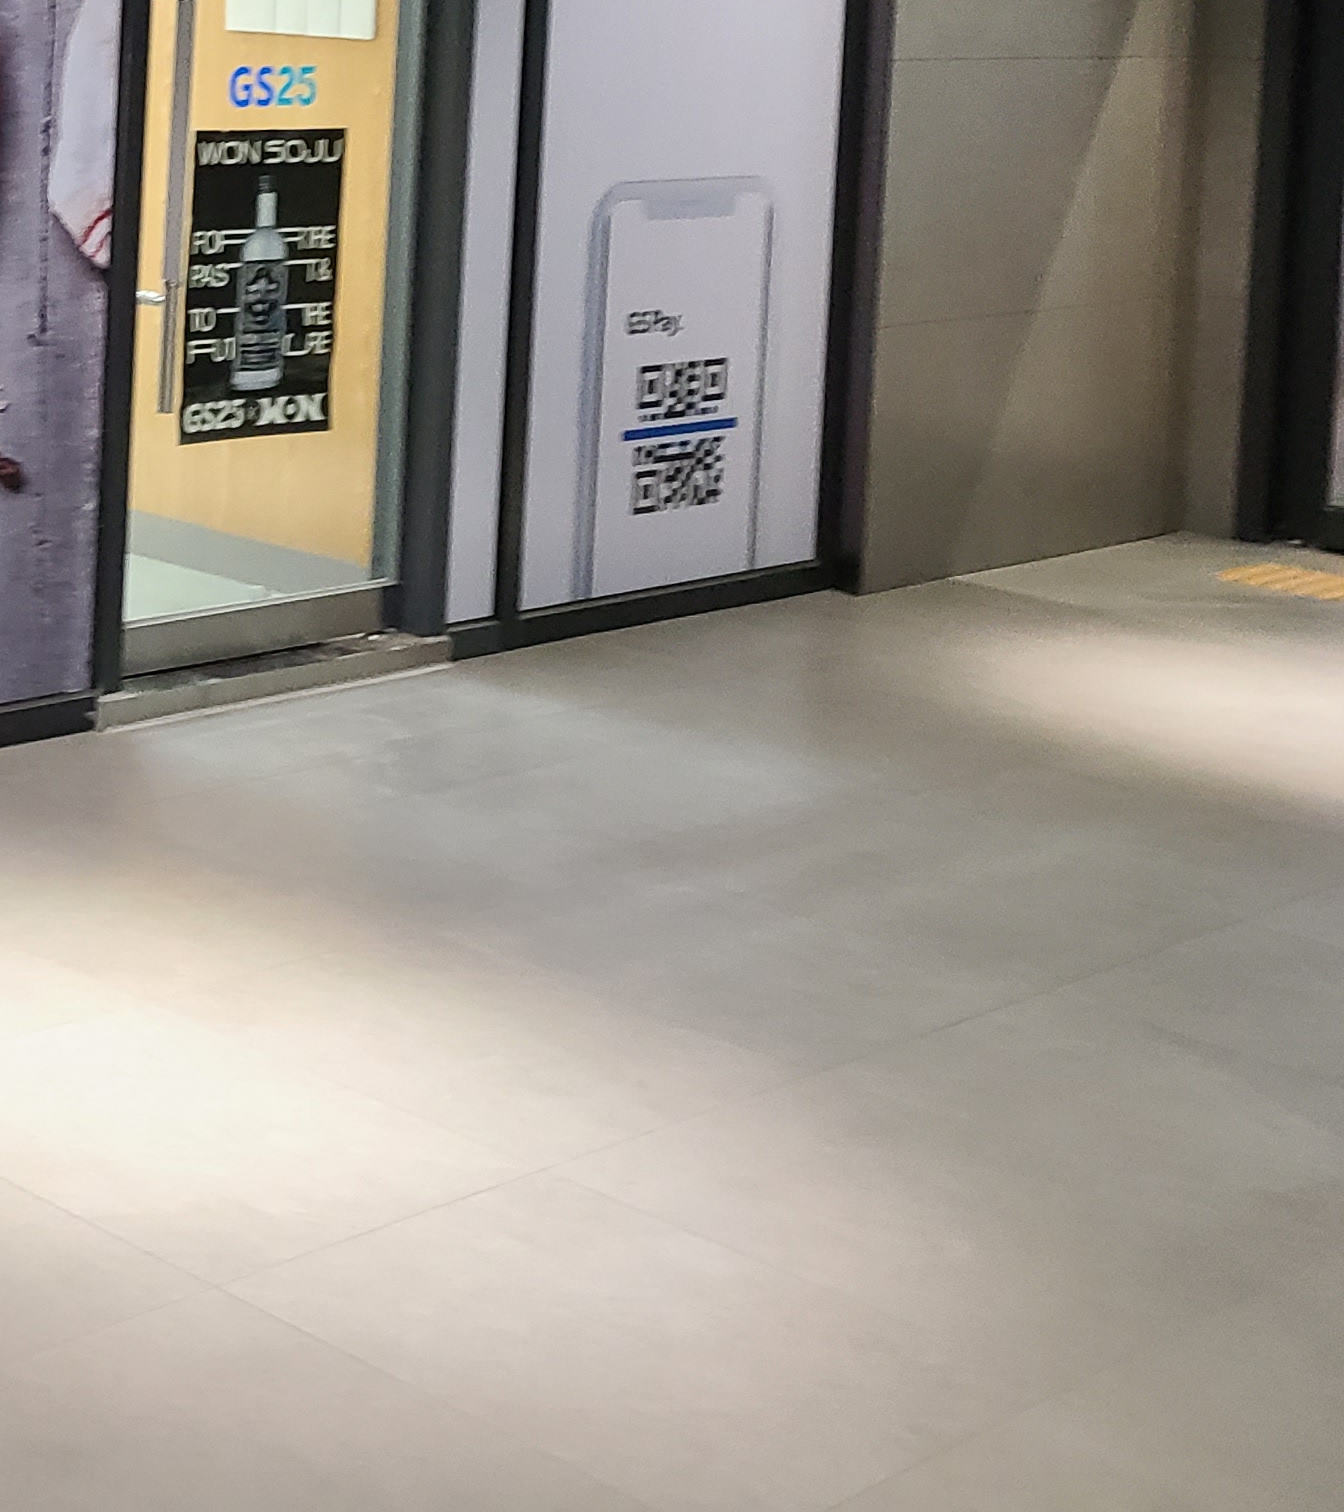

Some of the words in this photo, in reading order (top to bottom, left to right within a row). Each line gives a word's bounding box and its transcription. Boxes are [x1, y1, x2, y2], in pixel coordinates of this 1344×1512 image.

[229, 66, 317, 107] GS25
[197, 139, 263, 166] WON
[263, 138, 344, 165] SOJU
